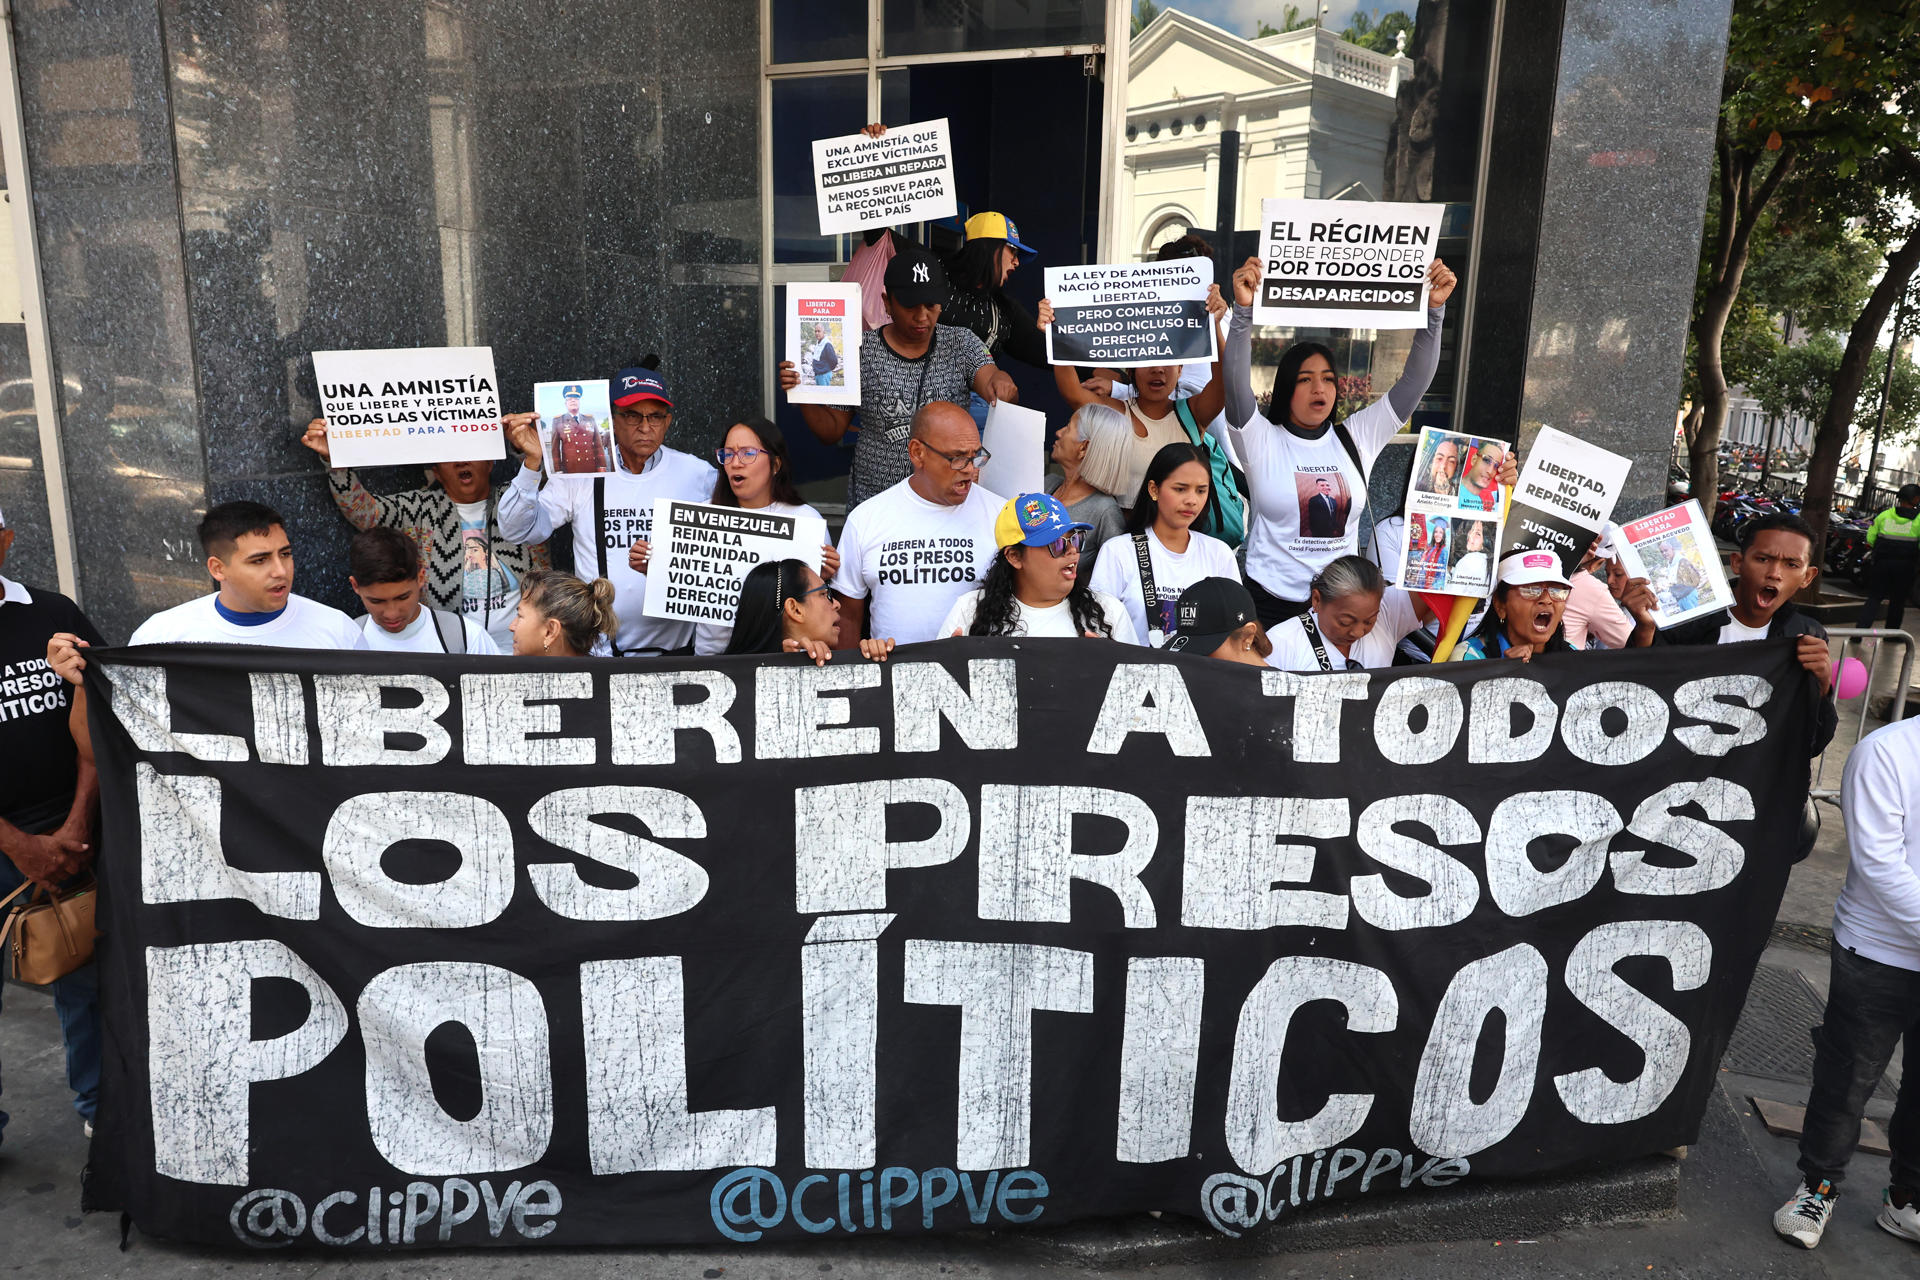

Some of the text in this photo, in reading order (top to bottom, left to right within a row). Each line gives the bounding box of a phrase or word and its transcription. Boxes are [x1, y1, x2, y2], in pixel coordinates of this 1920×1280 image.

[826, 131, 938, 158] UNA AMNISTÍA QUE
[828, 144, 938, 168] EXCLUYE VÍCTIMAS
[824, 158, 945, 185] NO LIBERA NI REPARA
[828, 177, 941, 202] MENOS SIRVE PARA
[828, 187, 944, 214] LA RECONCILIACIÓN
[860, 203, 912, 220] DEL PAÍS
[1270, 218, 1430, 245] EL RÉGIMEN
[1270, 245, 1424, 262] DEBE RESPONDER
[1064, 272, 1080, 280] LA
[1084, 271, 1107, 280] LEY
[1131, 264, 1194, 276] AMNISTÍA
[1268, 260, 1424, 278] POR TODOS LOS
[1058, 276, 1200, 292] NACIÓ PROMETIENDO
[1093, 291, 1160, 303] LIBERTAD,
[1268, 286, 1414, 304] DESAPARECIDOS
[1076, 303, 1182, 320] PERO COMENZÓ
[1058, 318, 1202, 334] NEGANDO INCLUSO EL
[1092, 332, 1169, 346] DERECHO A
[1089, 346, 1173, 358] SOLICITARLA
[322, 375, 493, 398] UNA AMNISTÍA
[326, 396, 496, 412] QUE LIBERE Y REPARE A
[327, 408, 498, 426] TODAS LAS VÍCTIMAS
[331, 423, 498, 439] LIBERTAD PARA TODOS
[1538, 460, 1606, 497] LIBERTAD,
[1558, 481, 1578, 498] NO
[1525, 483, 1600, 521] REPRESIÓN
[604, 508, 636, 518] BEREN
[639, 508, 646, 517] A
[674, 508, 695, 523] EN
[698, 511, 790, 536] VENEZUELA
[1635, 512, 1676, 531] LIBERTAD
[604, 520, 652, 532] OS PRE
[1520, 519, 1576, 551] JUSTICIA,
[1648, 522, 1672, 535] PARA
[1662, 526, 1690, 540] ACEVEDO
[672, 526, 742, 546] REINA LA
[882, 538, 973, 552] LIBEREN A TODOS
[1536, 538, 1555, 551] NO
[671, 542, 760, 564] IMPUNIDAD
[880, 550, 974, 567] LOS PRESOS
[669, 557, 733, 576] ANTE LA
[878, 564, 976, 585] POLÍTICOS
[668, 571, 742, 592] VIOLACIÓ
[666, 586, 740, 607] DERECHO
[1144, 580, 1156, 607] GUESS
[462, 598, 478, 613] OU
[665, 601, 737, 622] HUMANO
[1181, 607, 1196, 618] VEN
[5, 658, 52, 677] A TOD
[0, 672, 62, 697] RESOS
[101, 658, 1774, 766] LIBEREN A TODOS
[136, 761, 1756, 932] LOS PRESOS
[145, 912, 1713, 1187] POLÍTICOS
